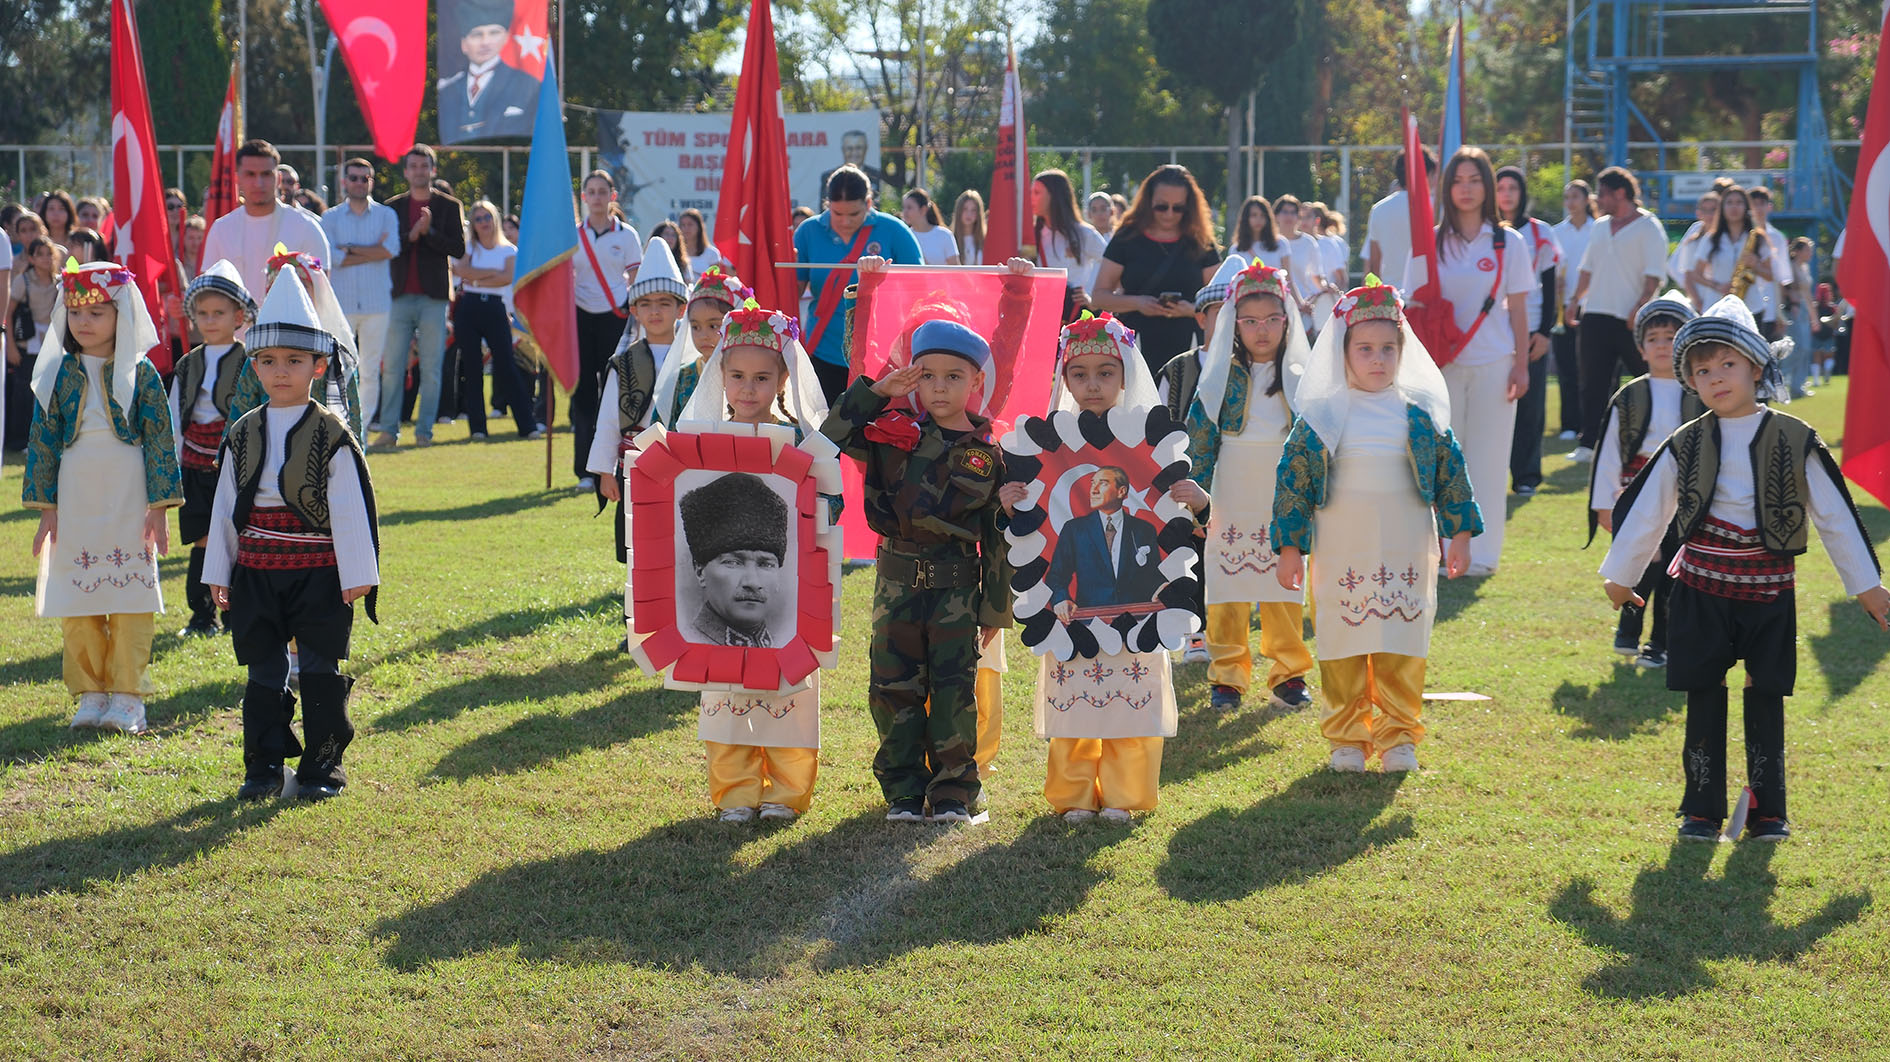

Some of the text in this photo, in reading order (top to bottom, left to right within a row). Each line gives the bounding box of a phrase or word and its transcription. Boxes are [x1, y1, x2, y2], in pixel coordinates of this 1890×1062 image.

[642, 128, 828, 148] TÜM SPOARA
[679, 199, 713, 209] WISH
